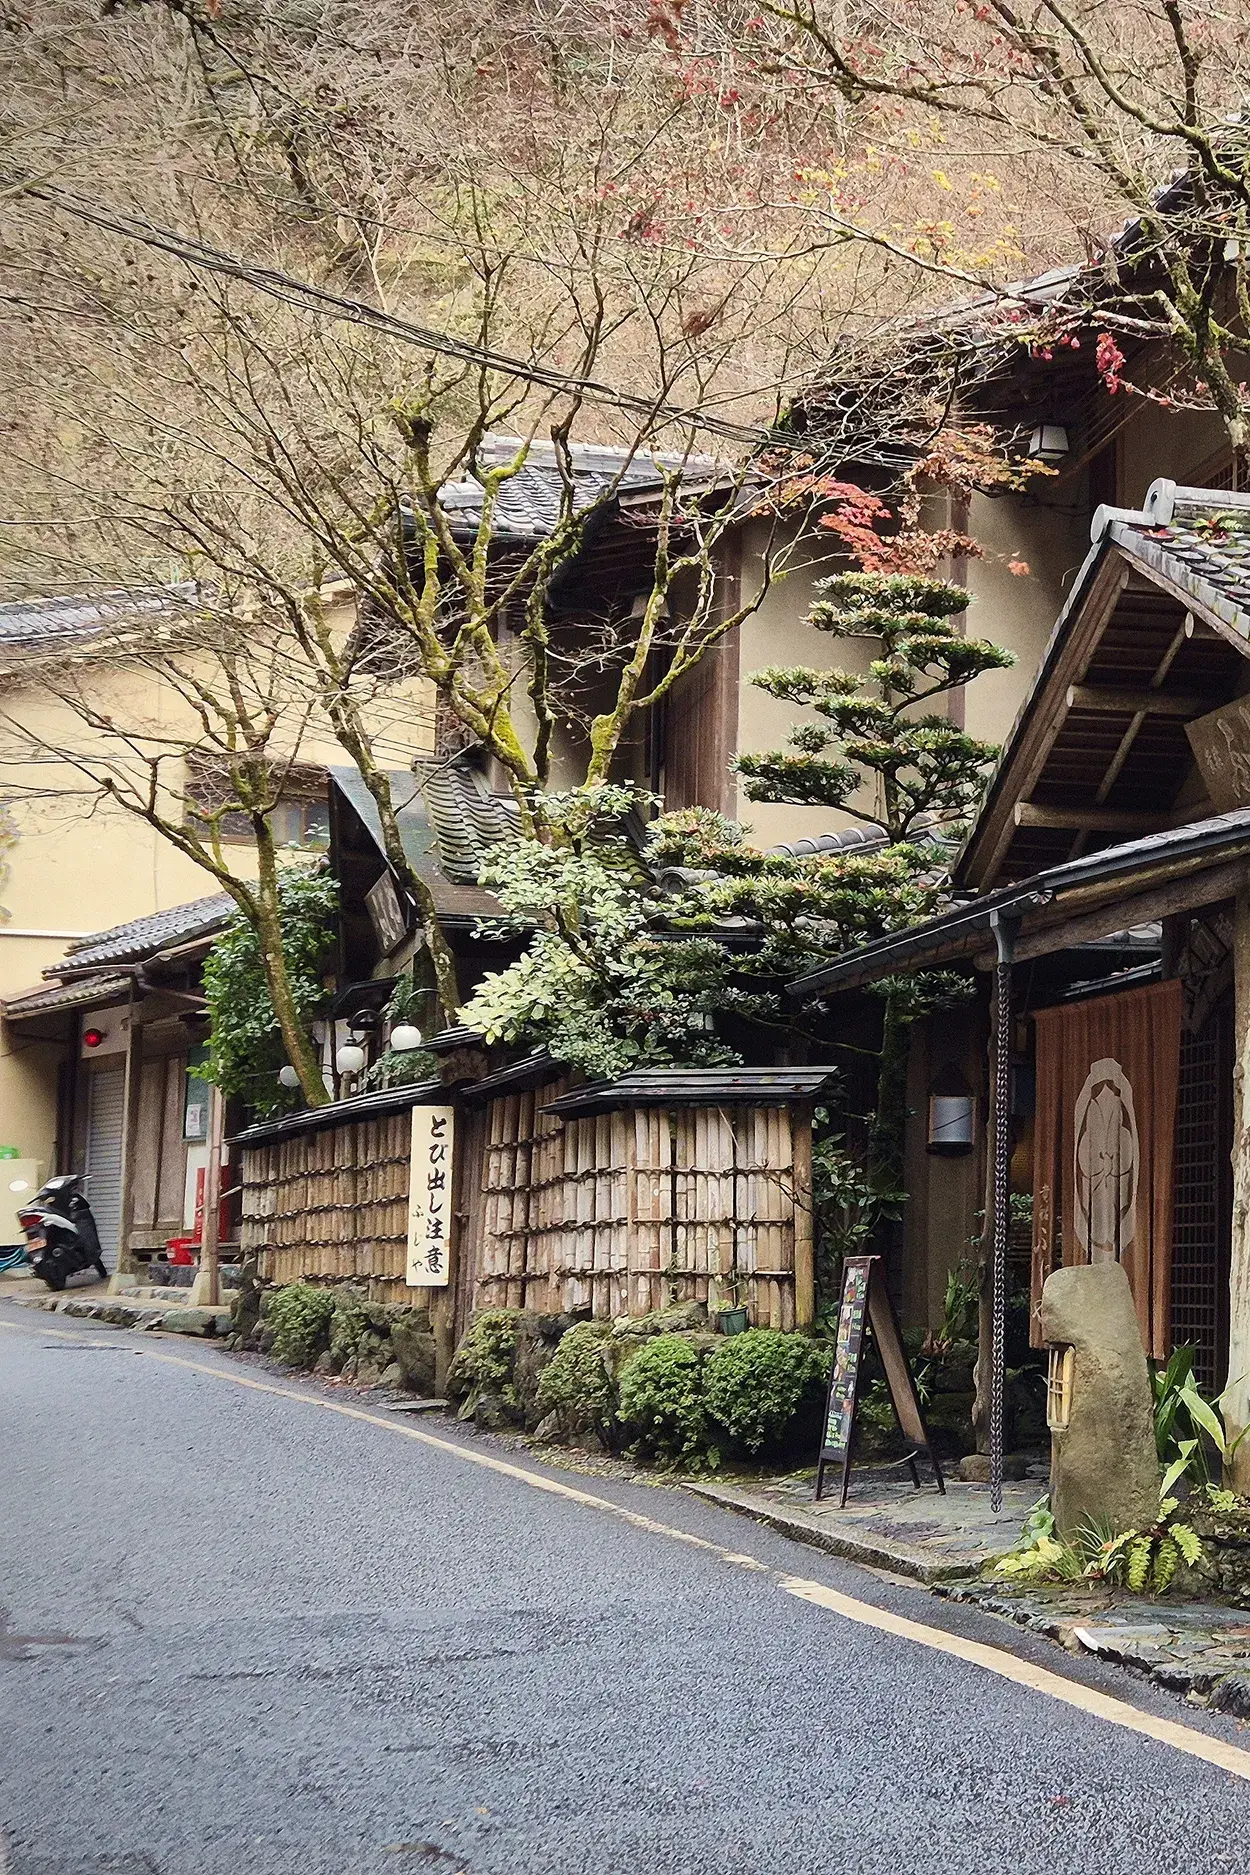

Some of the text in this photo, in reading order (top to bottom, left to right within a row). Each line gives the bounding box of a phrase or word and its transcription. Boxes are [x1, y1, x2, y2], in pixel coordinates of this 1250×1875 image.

[411, 1204, 425, 1273] ふじや
[424, 1115, 449, 1274] とび出し注意
